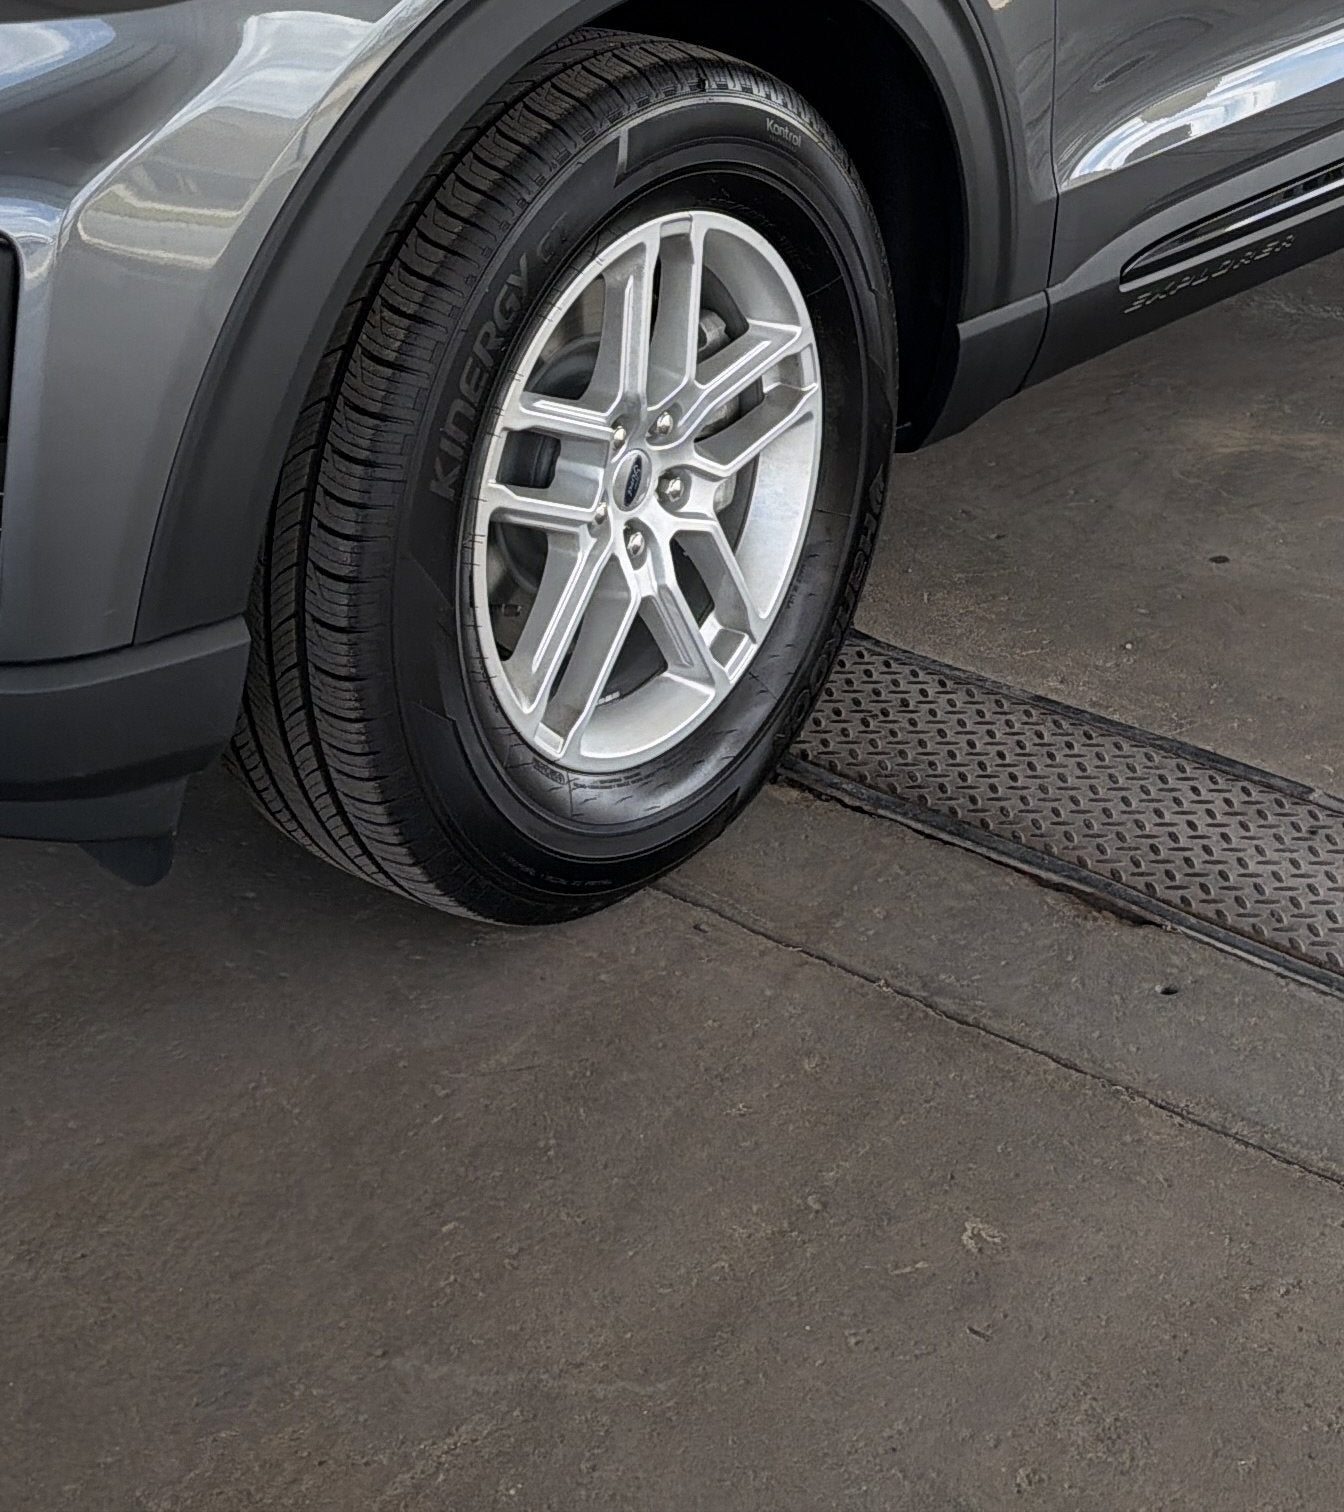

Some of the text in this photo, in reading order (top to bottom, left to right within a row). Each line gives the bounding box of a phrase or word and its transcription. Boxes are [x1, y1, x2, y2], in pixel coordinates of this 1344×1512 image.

[766, 117, 802, 147] Kontrol
[1123, 234, 1295, 314] EXPLORER
[429, 252, 529, 502] KINERGY
